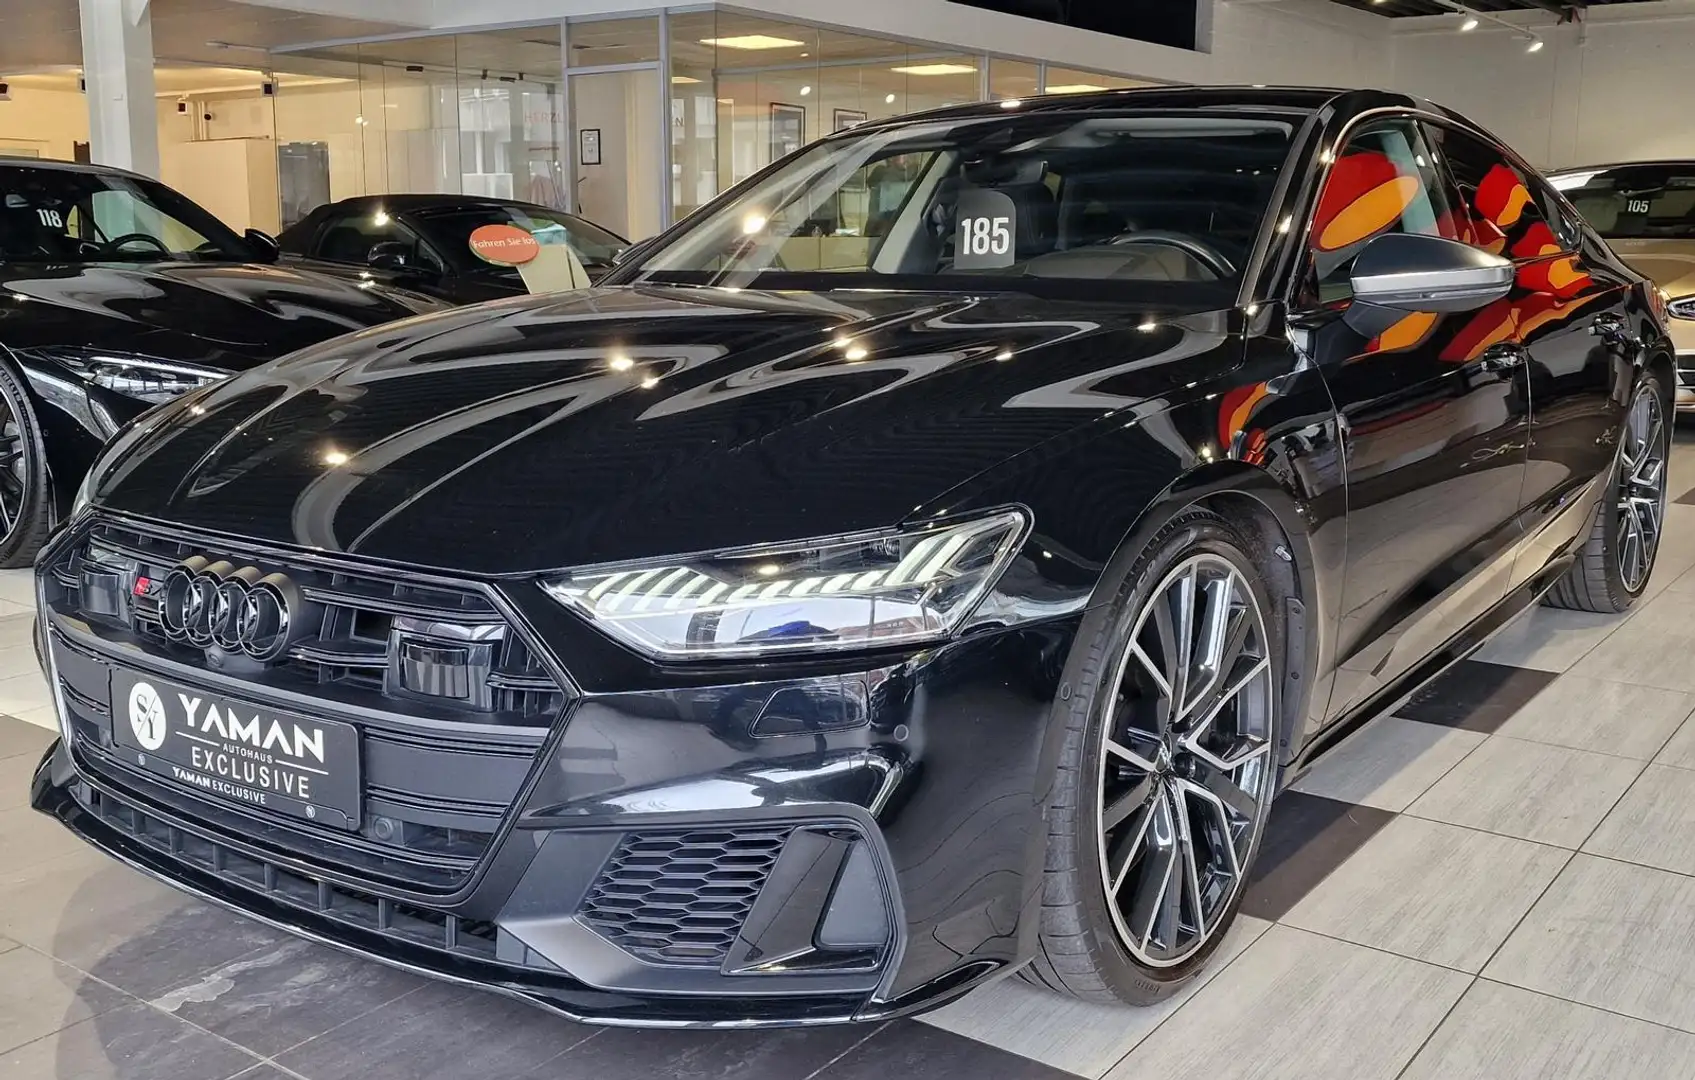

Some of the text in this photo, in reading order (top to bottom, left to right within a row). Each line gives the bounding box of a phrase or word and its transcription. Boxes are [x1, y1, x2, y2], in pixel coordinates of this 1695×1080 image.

[36, 208, 62, 228] 118
[1627, 199, 1650, 213] 105
[472, 239, 506, 249] Fahren
[507, 237, 521, 246] Sie
[961, 216, 1010, 255] 185
[178, 693, 324, 763] YAMAN
[222, 743, 273, 764] AUTOHAUS
[172, 766, 266, 805] YAMAN EXCLUSIVE
[191, 747, 310, 799] EXCLUSIVE
